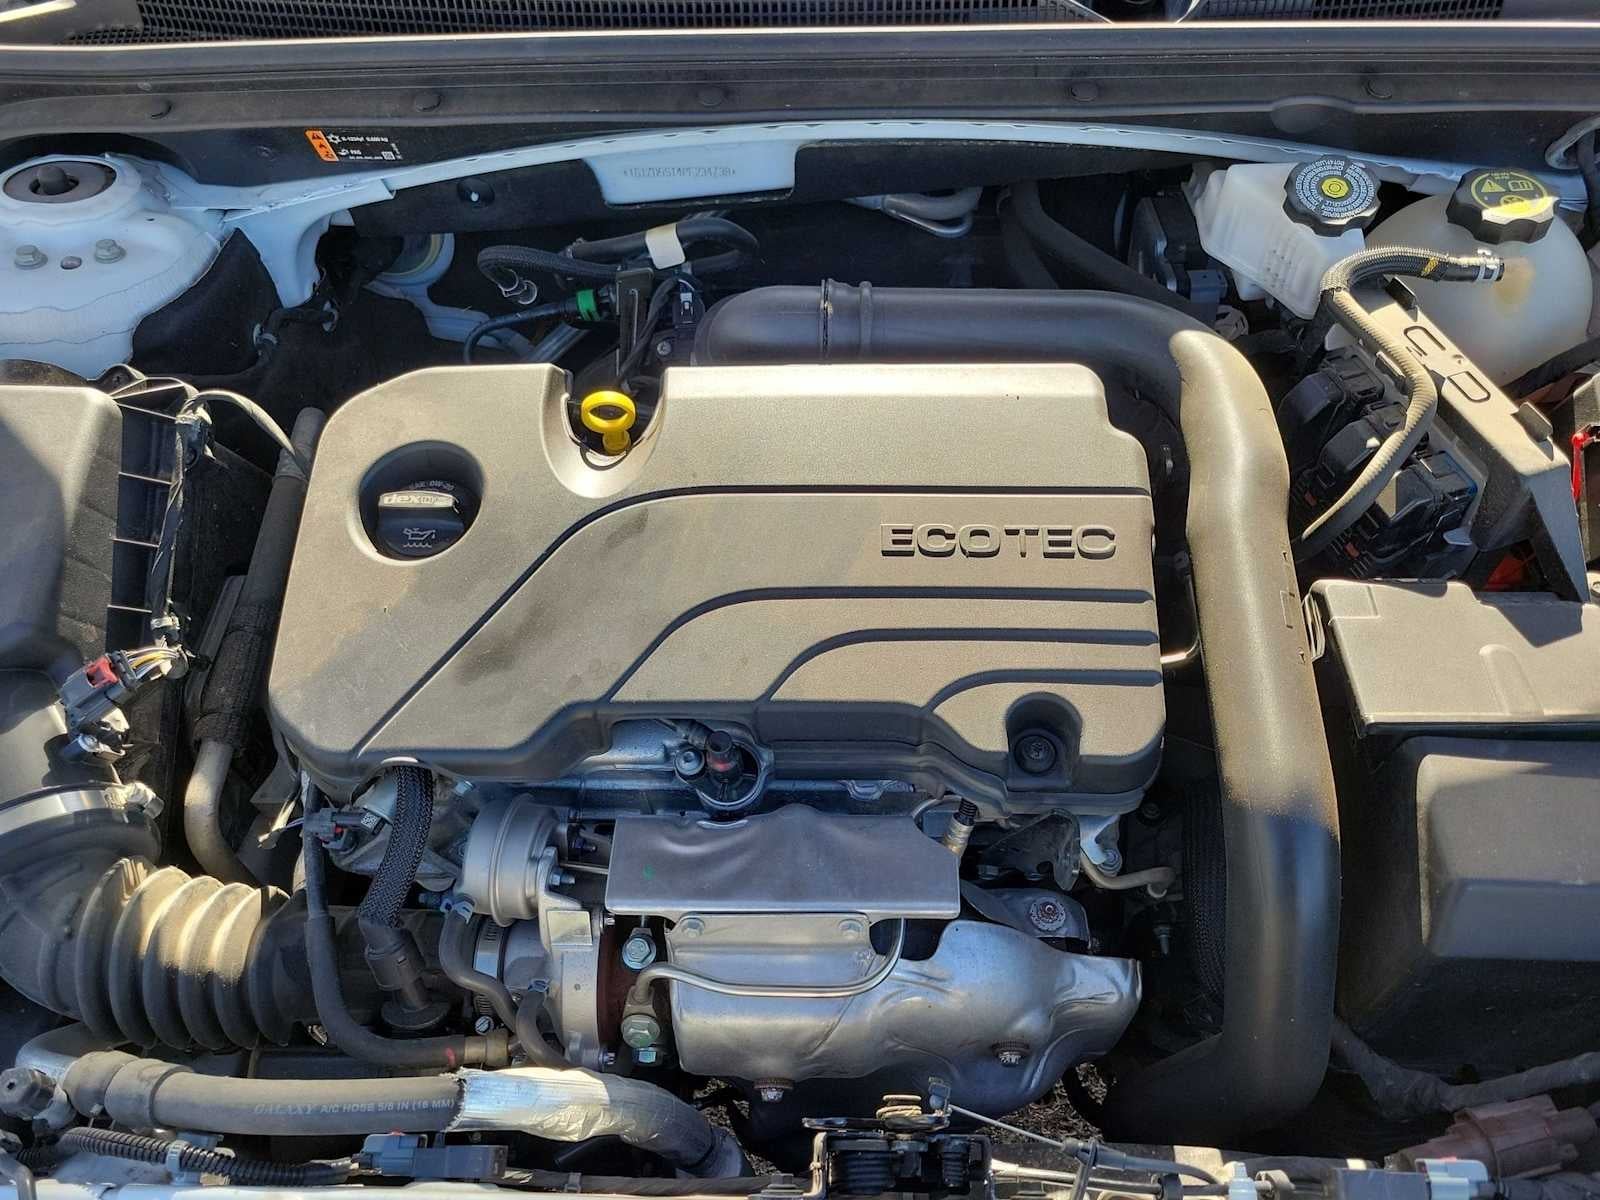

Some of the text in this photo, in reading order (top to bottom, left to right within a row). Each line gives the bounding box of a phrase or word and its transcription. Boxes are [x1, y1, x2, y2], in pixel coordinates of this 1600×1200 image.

[880, 523, 1117, 560] ECOTEC
[342, 1103, 375, 1113] HOSE
[397, 1100, 409, 1111] IN
